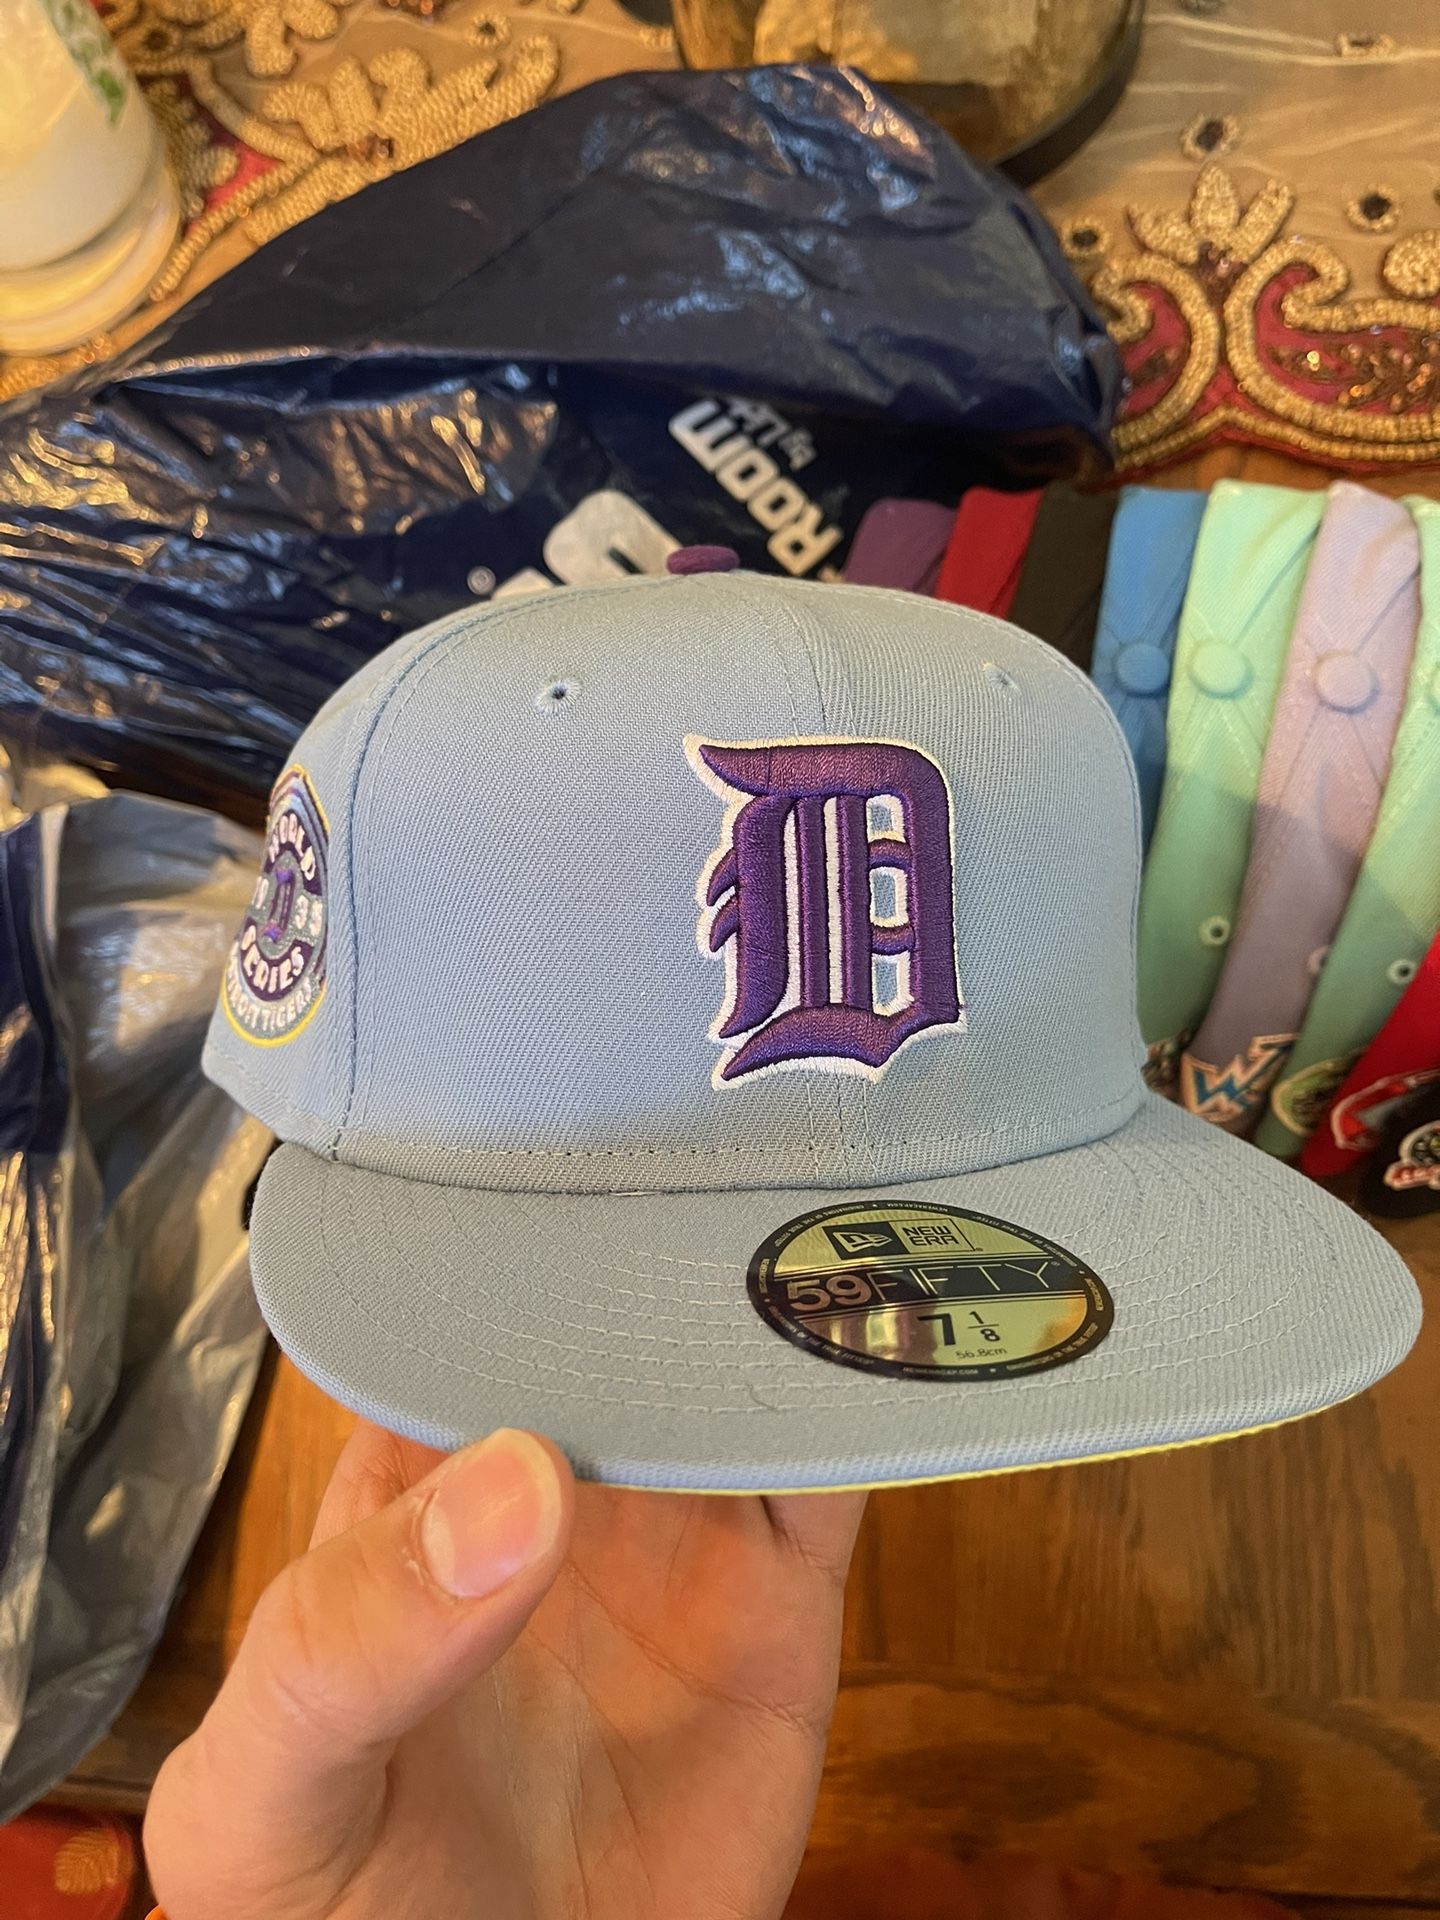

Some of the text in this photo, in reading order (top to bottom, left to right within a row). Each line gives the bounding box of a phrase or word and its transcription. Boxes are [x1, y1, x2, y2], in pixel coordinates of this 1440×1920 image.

[668, 399, 844, 577] Room
[268, 812, 316, 881] WORLD
[683, 734, 968, 1091] D
[241, 925, 304, 993] SERIES
[261, 976, 312, 1031] TIGERS
[901, 1225, 953, 1238] NEW
[909, 1233, 959, 1247] ERA
[787, 1261, 1050, 1311] 59FIFTY
[917, 1312, 956, 1346] 7
